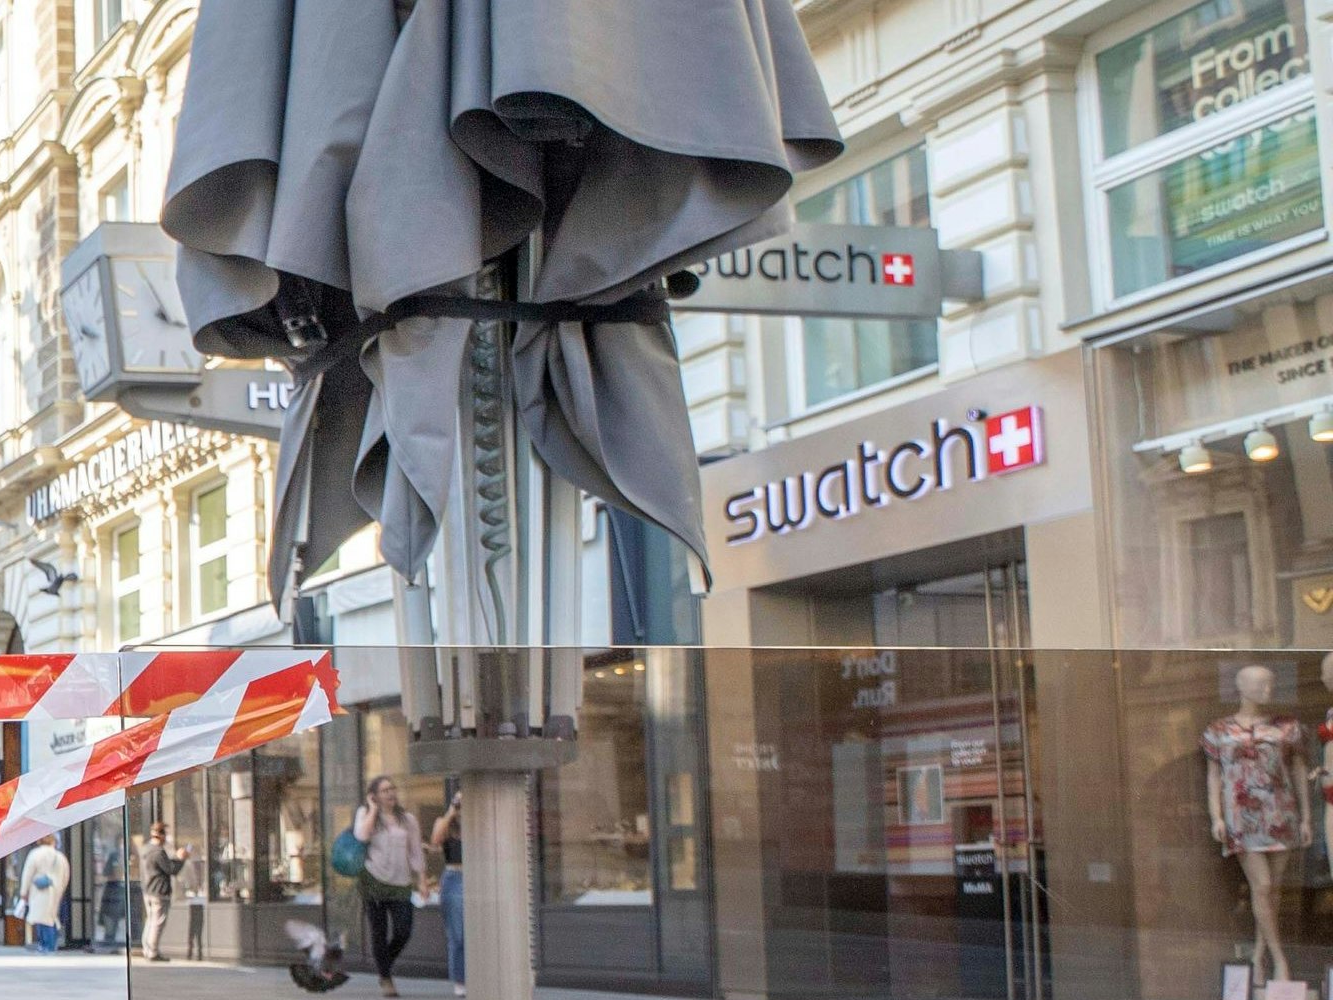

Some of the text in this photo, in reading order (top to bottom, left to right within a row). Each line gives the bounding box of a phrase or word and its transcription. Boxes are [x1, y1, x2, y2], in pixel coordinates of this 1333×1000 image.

[1191, 23, 1296, 90] From
[1193, 55, 1309, 122] collec
[1200, 178, 1285, 222] swatch
[725, 407, 987, 546] swatch
